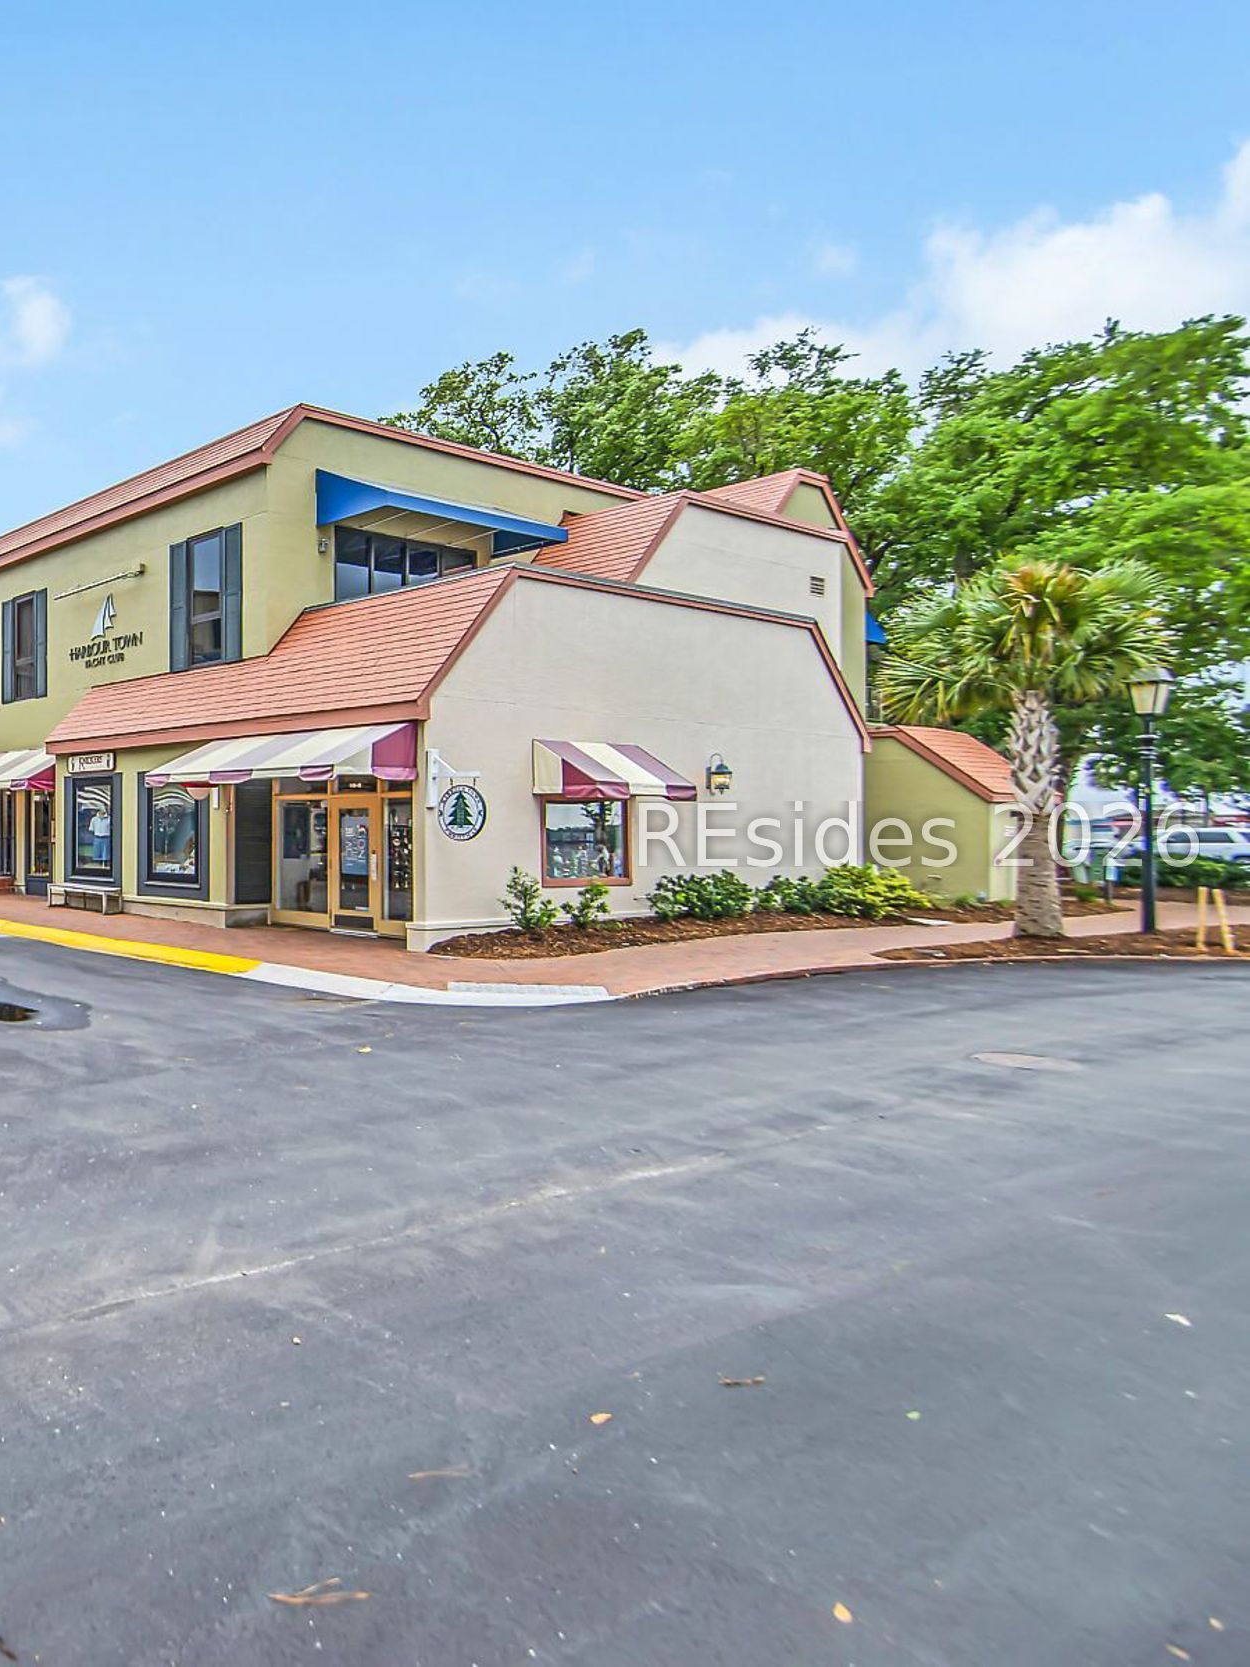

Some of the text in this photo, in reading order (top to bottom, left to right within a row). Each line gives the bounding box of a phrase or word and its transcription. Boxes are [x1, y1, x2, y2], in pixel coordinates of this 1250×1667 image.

[69, 631, 143, 661] HARBOUR TOWN
[107, 652, 125, 664] CLUB
